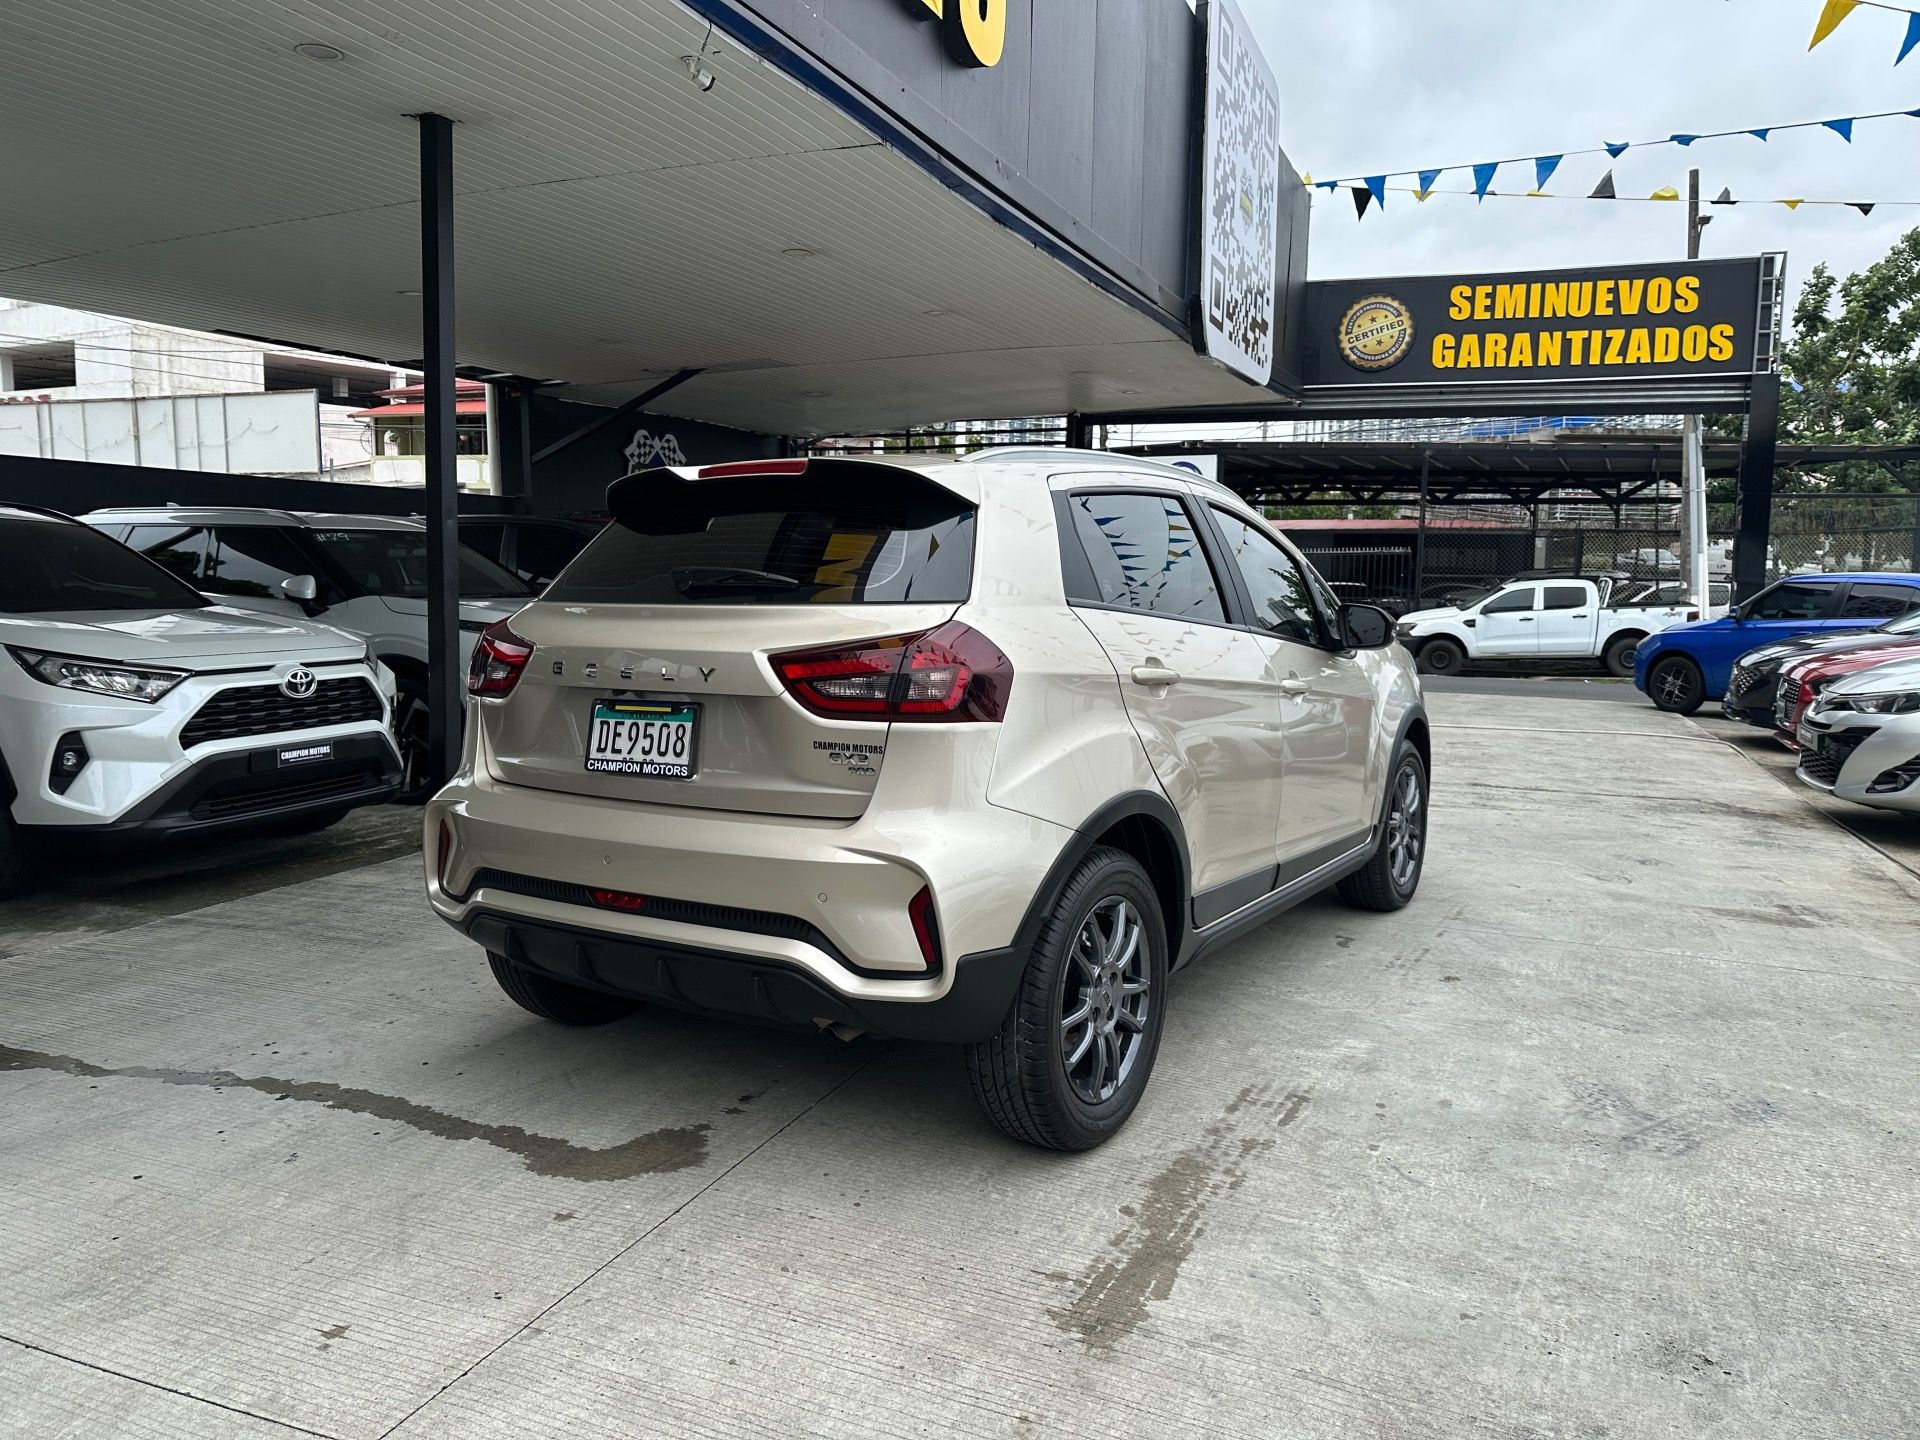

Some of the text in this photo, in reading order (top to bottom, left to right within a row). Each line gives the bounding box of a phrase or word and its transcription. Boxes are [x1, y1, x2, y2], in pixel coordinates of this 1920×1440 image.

[1449, 275, 1700, 321] SEMINUEVOS
[1347, 319, 1405, 345] CERTIFIED
[1432, 323, 1735, 369] GARANTIZADOS
[552, 661, 716, 682] GEELY
[596, 719, 687, 758] DE9508
[813, 740, 884, 755] CHAMPION MOTORS
[281, 749, 308, 760] CHAMPION
[309, 746, 330, 755] MOTORS
[828, 752, 870, 766] GX3
[587, 759, 640, 773] CHAMPION
[642, 763, 688, 777] MOTORS
[847, 766, 876, 776] PRO
